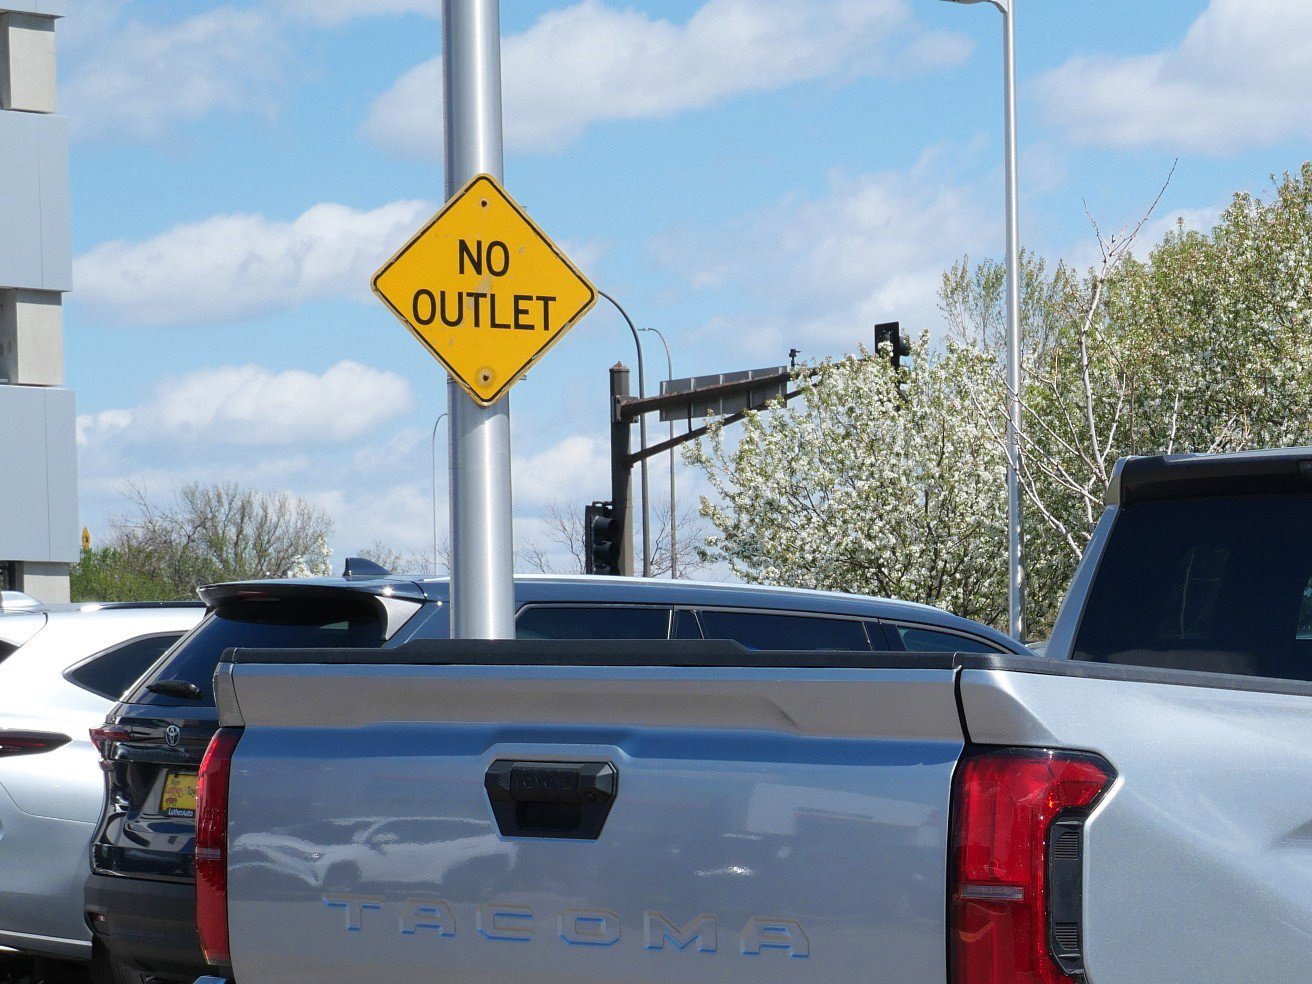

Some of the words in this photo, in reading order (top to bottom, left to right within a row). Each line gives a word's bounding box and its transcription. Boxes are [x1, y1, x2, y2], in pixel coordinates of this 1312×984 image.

[459, 239, 510, 277] NO
[412, 289, 556, 331] OUTLET
[322, 893, 810, 958] TACOMA
